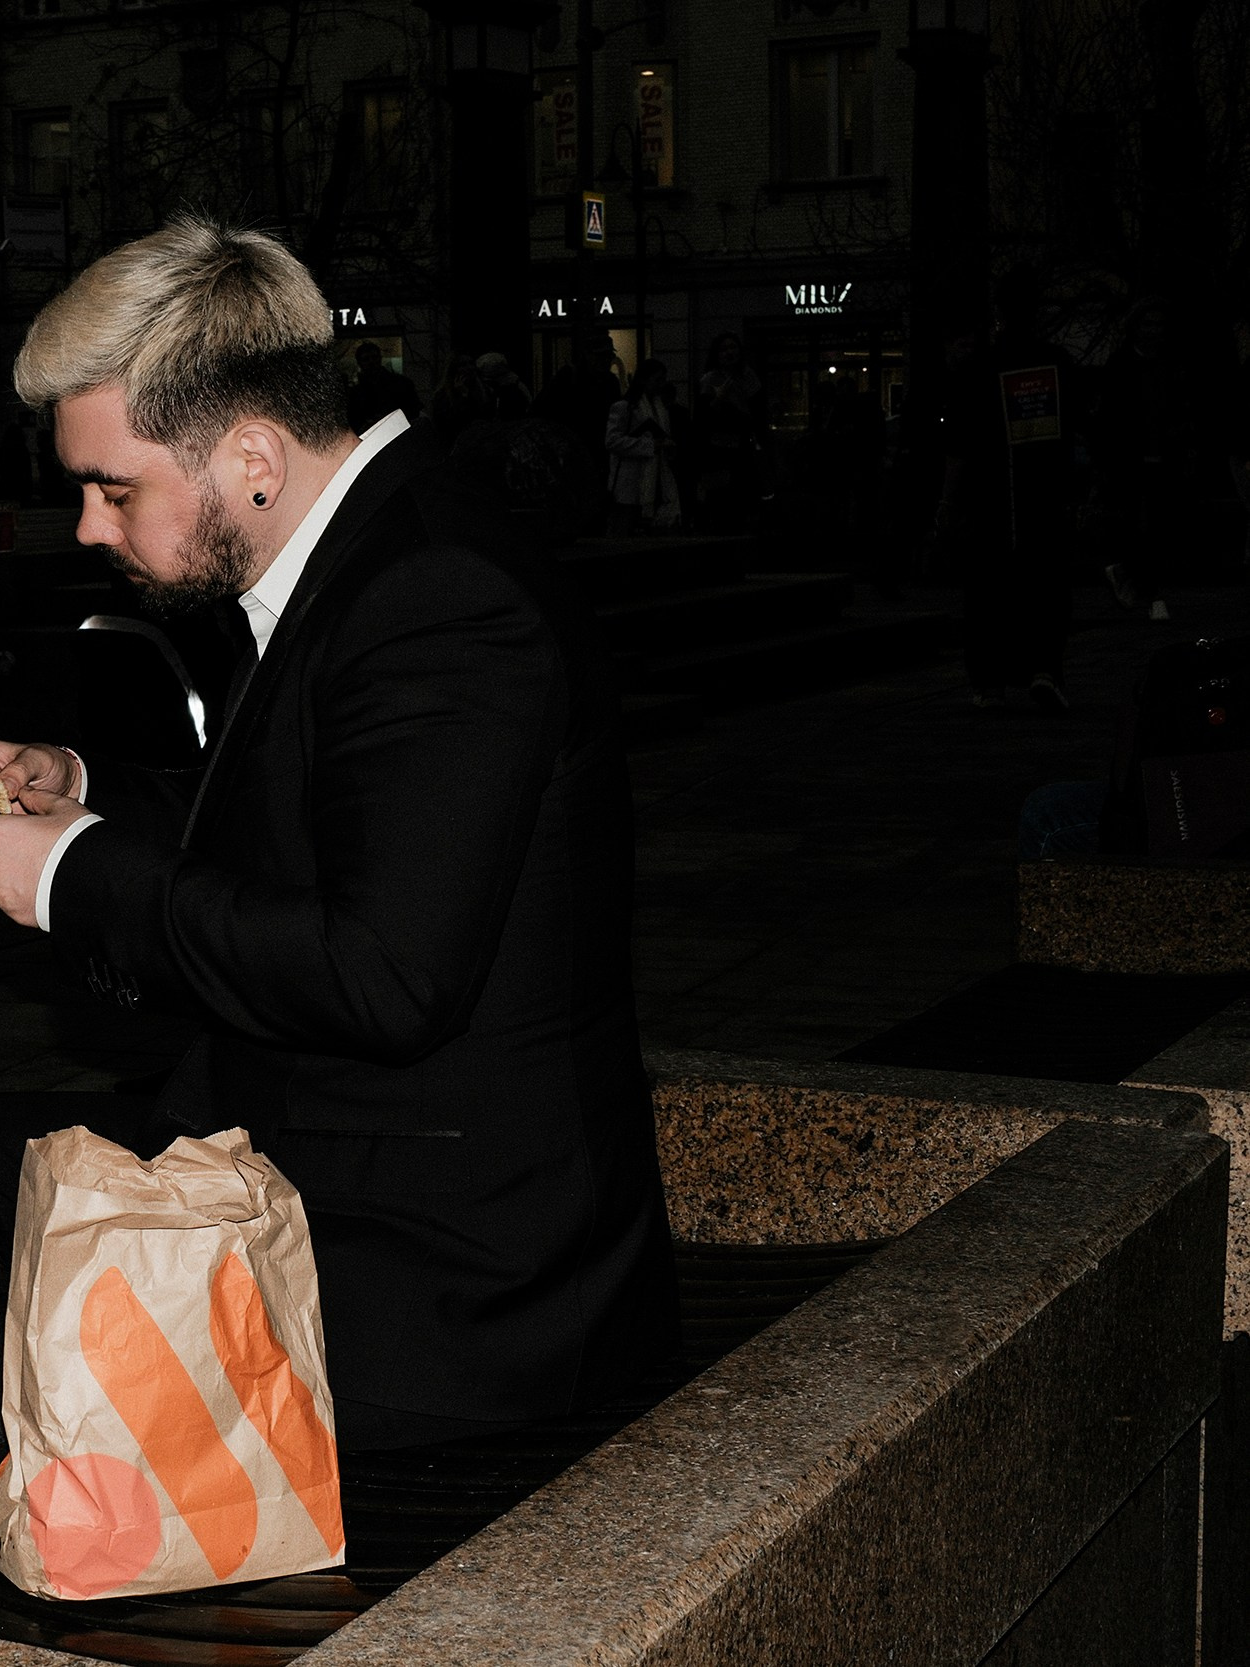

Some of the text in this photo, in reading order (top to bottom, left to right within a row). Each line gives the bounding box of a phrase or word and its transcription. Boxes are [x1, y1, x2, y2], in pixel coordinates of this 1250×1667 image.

[555, 92, 576, 160] SALE
[641, 84, 663, 153] SALE
[795, 306, 844, 316] DIAMONDS
